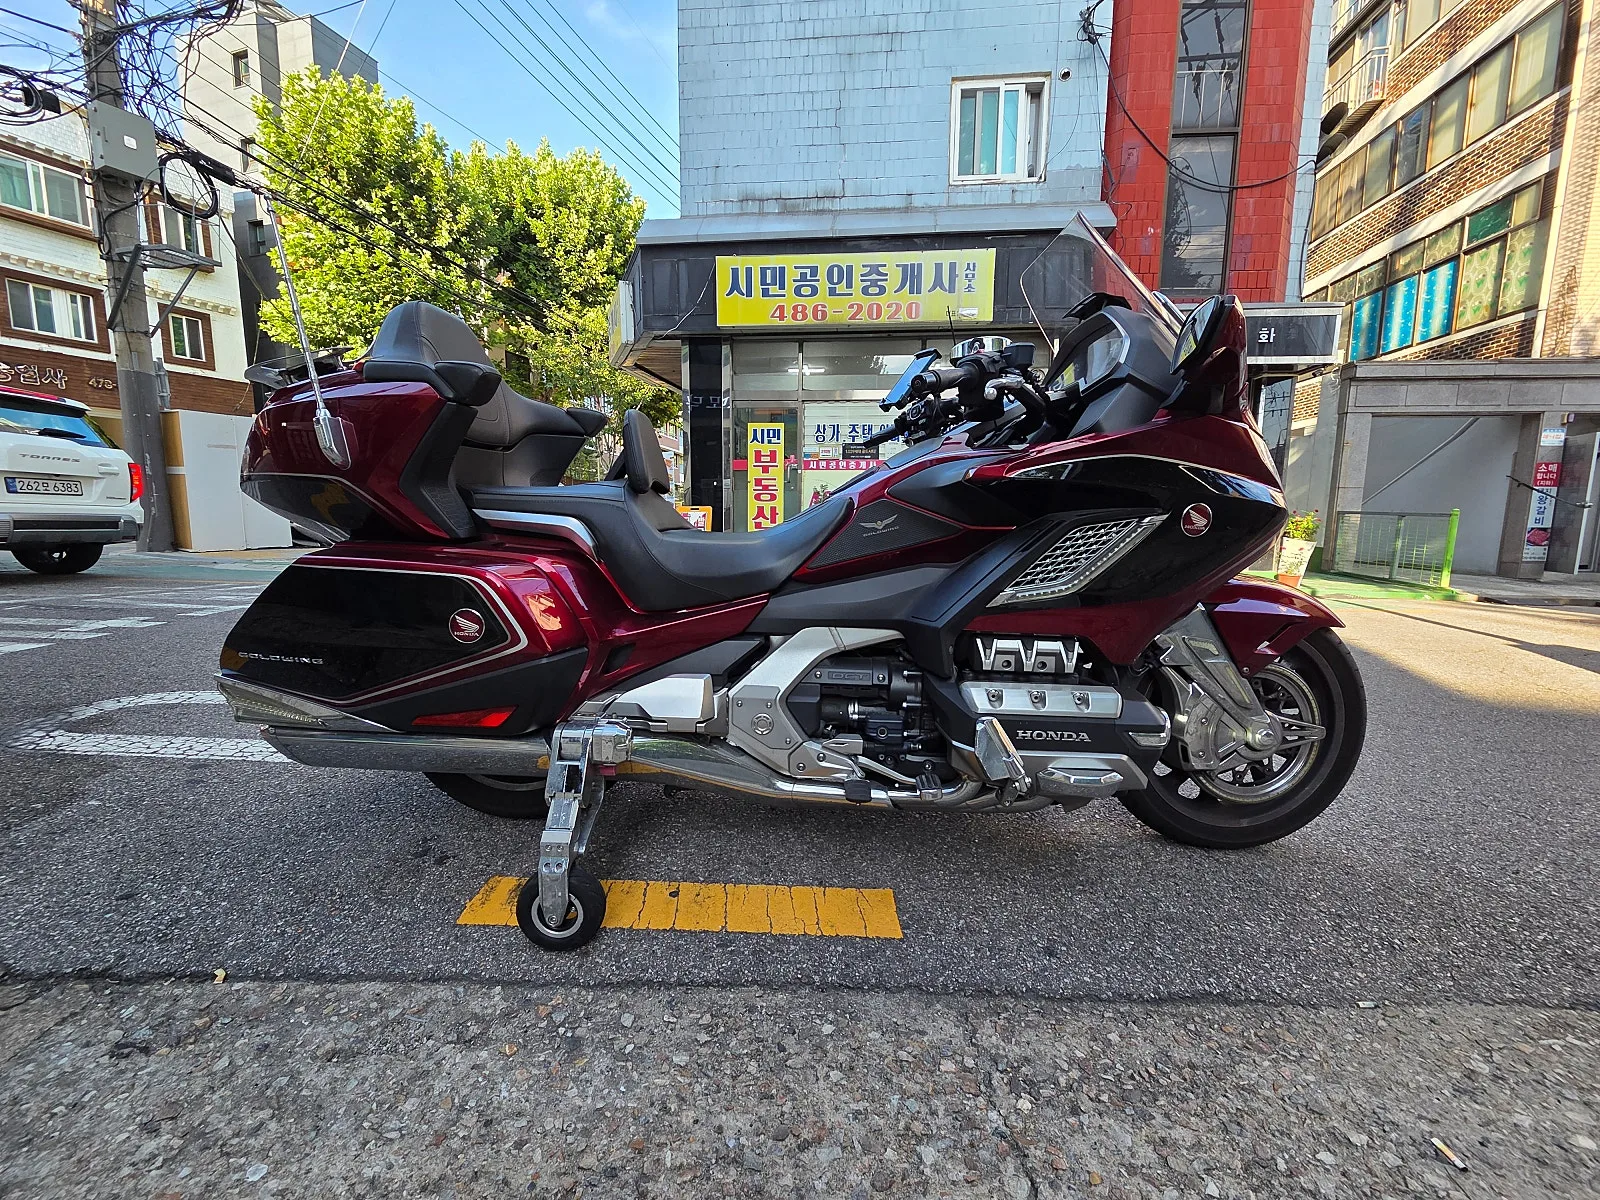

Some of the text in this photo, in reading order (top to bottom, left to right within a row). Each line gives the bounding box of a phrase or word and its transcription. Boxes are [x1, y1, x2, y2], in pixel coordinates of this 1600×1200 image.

[725, 261, 959, 298] 시민공인중개사
[964, 262, 977, 293] 사무소
[769, 301, 922, 322] 486-2020
[1257, 327, 1276, 343] 화
[749, 428, 782, 445] 시민
[19, 453, 81, 463] TORRES
[53, 482, 80, 493] 6383
[751, 449, 779, 530] 부동산
[238, 651, 324, 665] GOLDWING
[1015, 730, 1092, 742] HONDA
